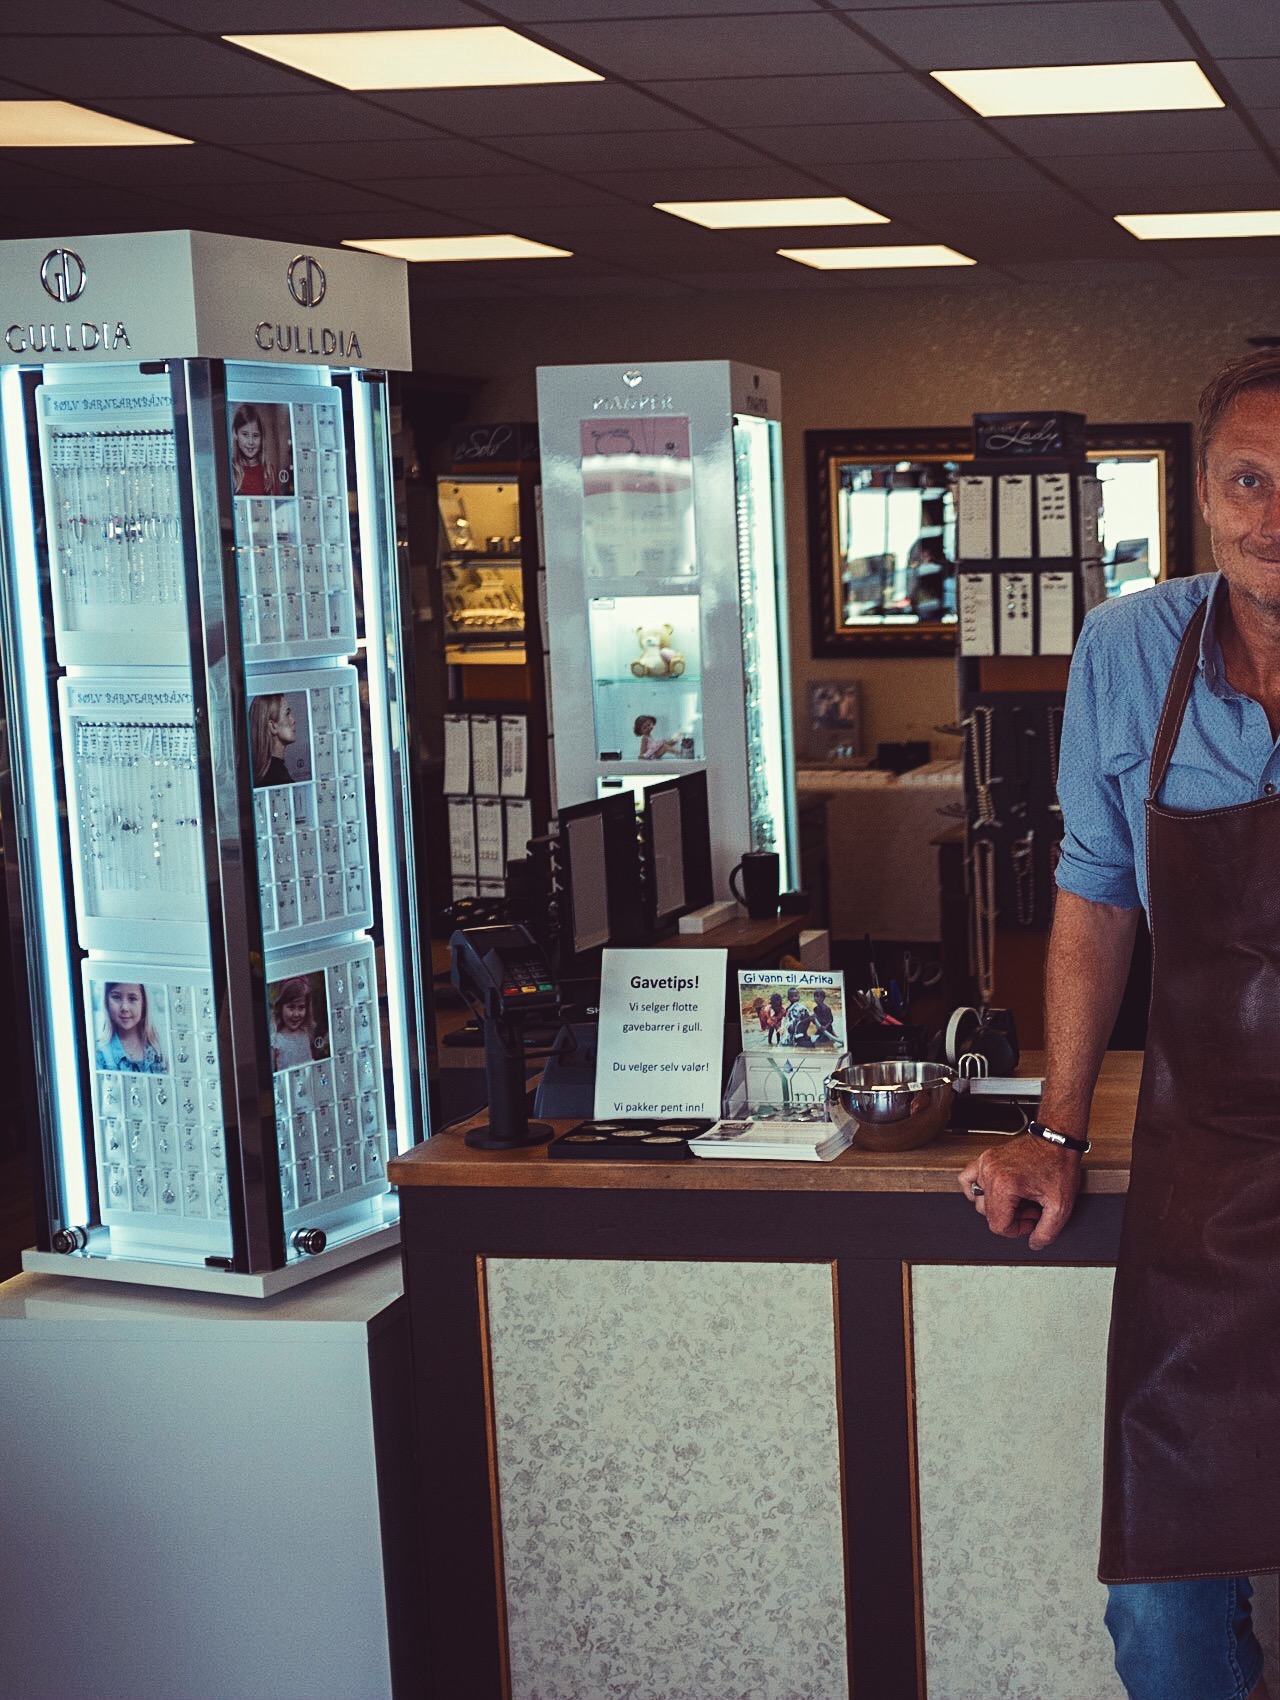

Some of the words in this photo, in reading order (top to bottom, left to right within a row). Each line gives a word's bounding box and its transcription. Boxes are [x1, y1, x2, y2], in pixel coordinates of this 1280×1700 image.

[5, 322, 132, 353] GULLDIA
[255, 321, 362, 359] GULLDIA
[630, 975, 699, 992] Gavetips!
[743, 973, 756, 984] Gi
[785, 973, 797, 984] til
[799, 974, 834, 985] Afrika
[628, 1001, 639, 1012] Vi
[640, 1001, 670, 1014] selger
[672, 1001, 699, 1012] flotte
[622, 1021, 675, 1034] gavebarrer
[682, 1021, 703, 1034] gull.
[612, 1062, 626, 1072] Du
[628, 1062, 658, 1074] velger
[660, 1062, 679, 1072] selv
[681, 1062, 709, 1072] valør!
[613, 1102, 624, 1112] Vi
[625, 1102, 658, 1113] pakker
[660, 1103, 683, 1114] pent
[685, 1102, 705, 1112] inn!
